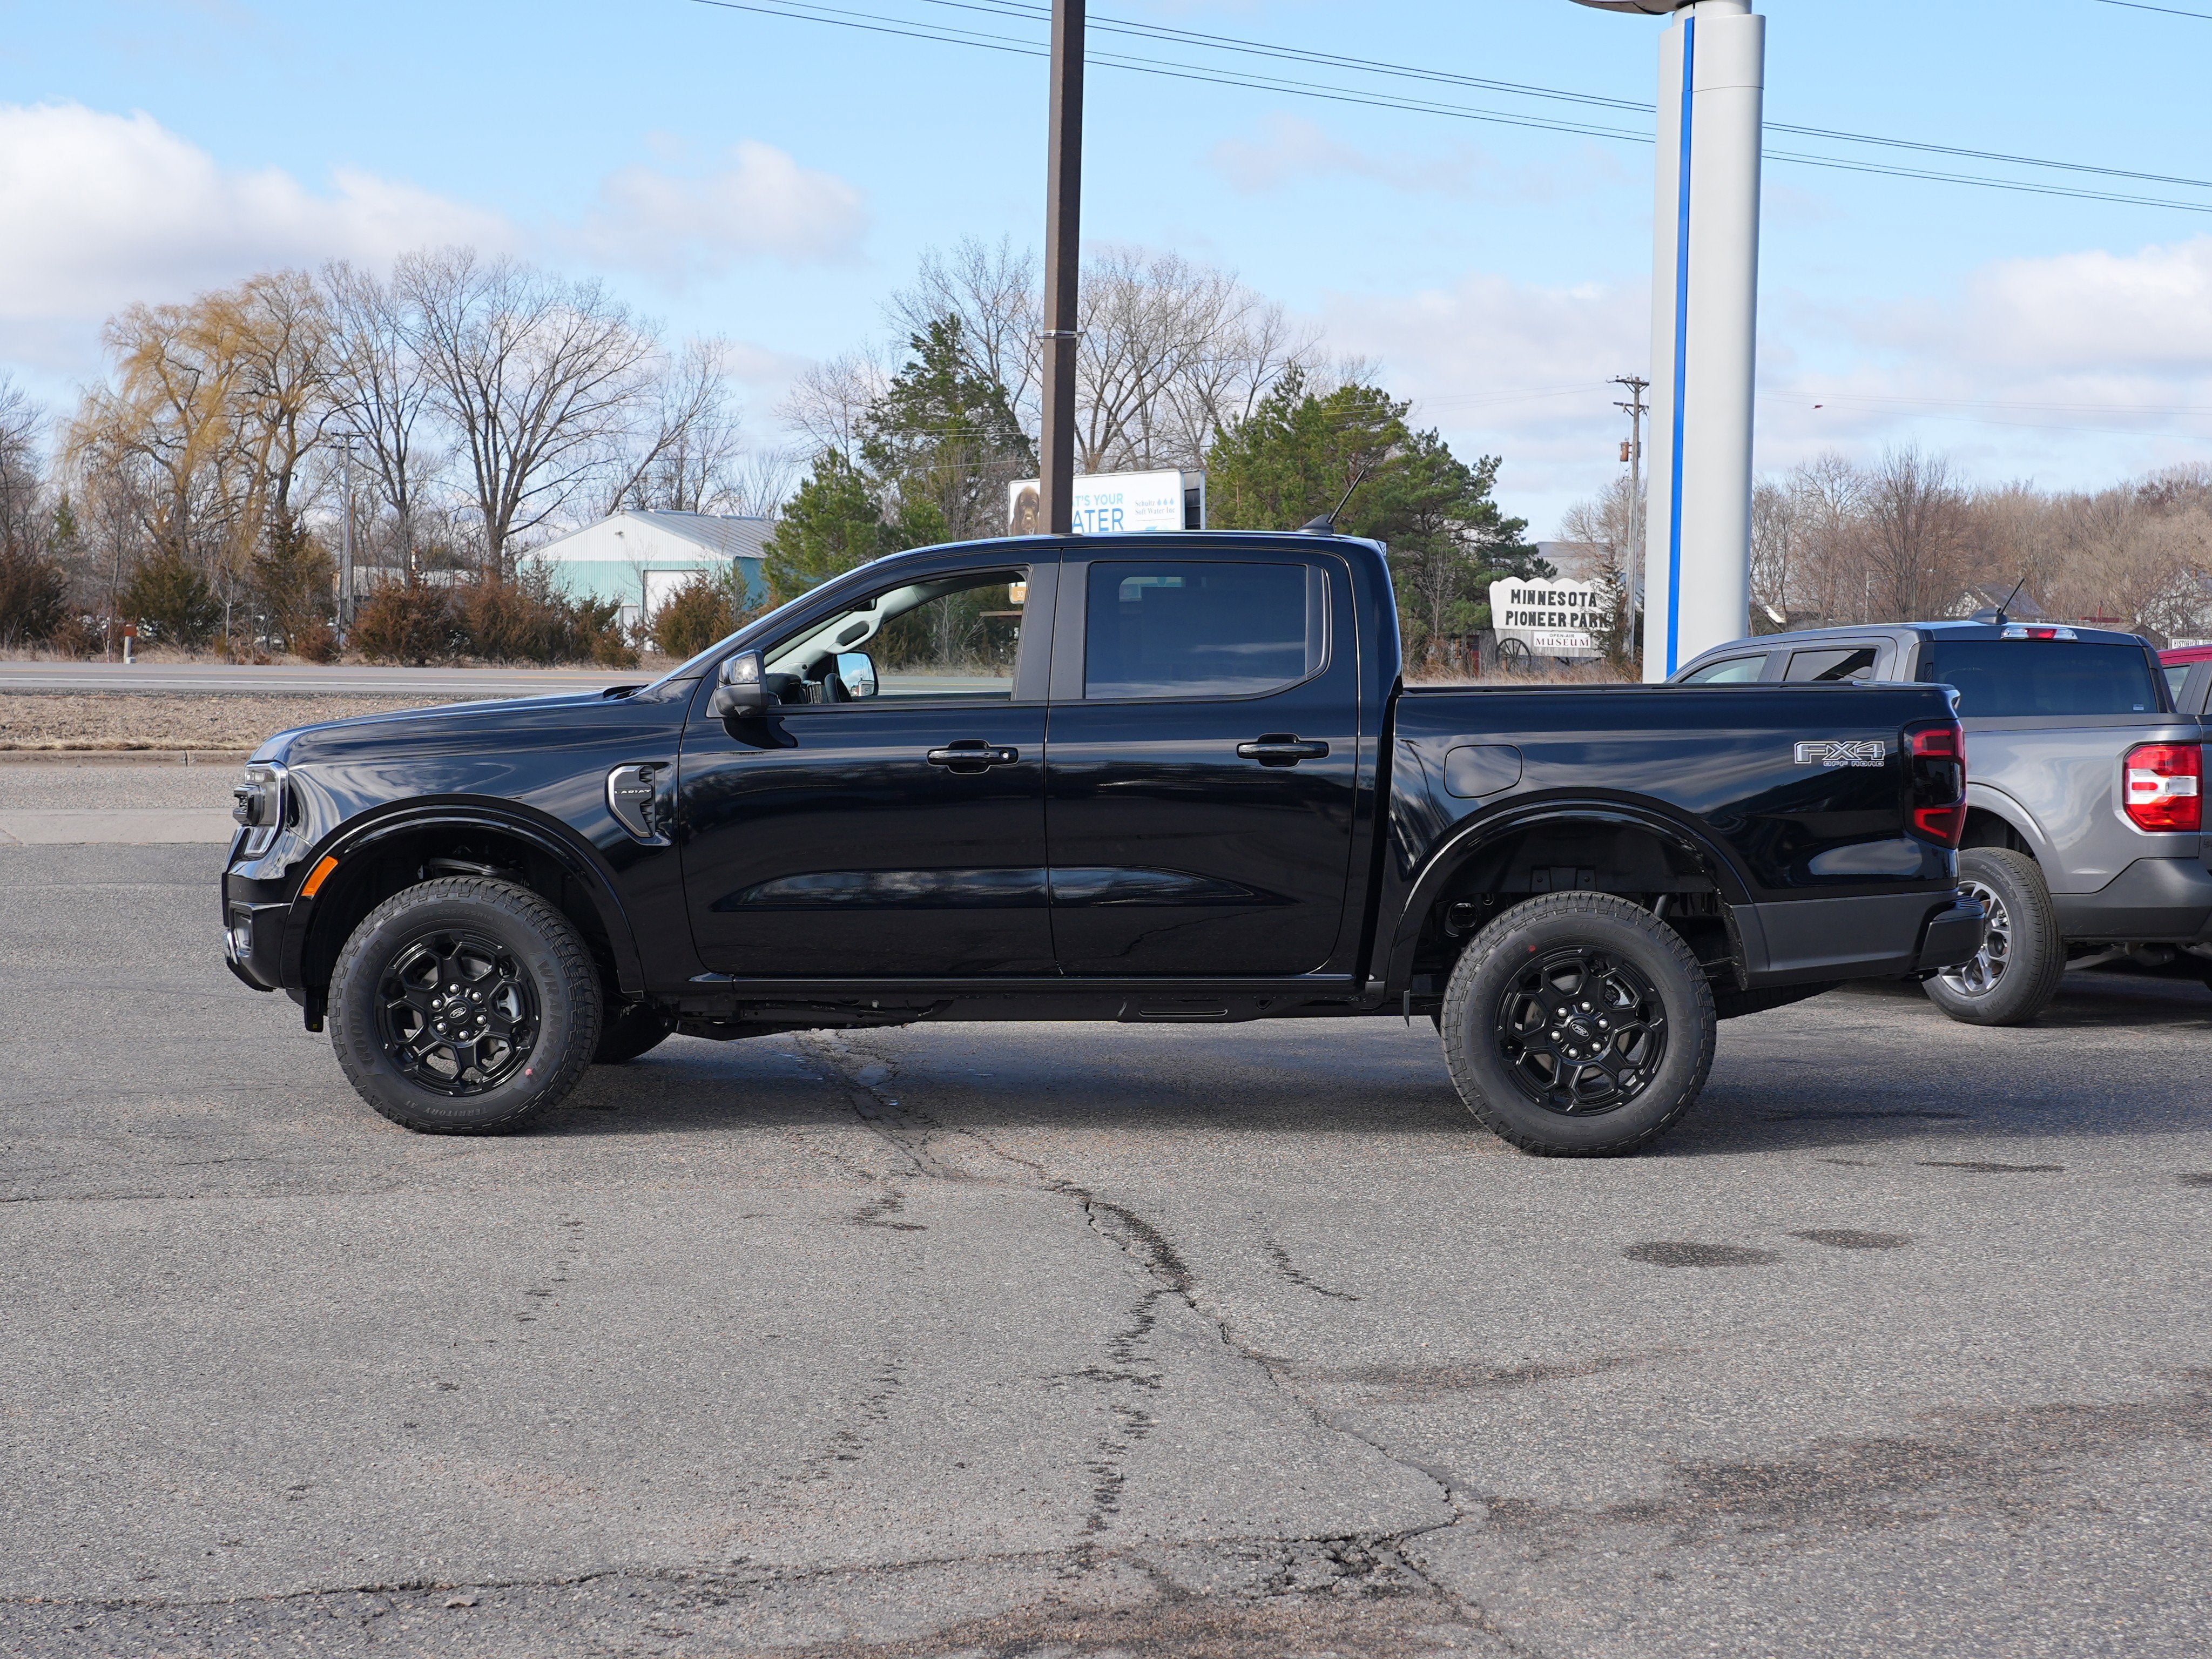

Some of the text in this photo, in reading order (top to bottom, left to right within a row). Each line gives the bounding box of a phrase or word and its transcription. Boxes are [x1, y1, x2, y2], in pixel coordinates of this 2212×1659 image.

[1072, 493, 1123, 507] T'S YOUR
[1510, 589, 1597, 607] MINNESOTA
[1506, 610, 1607, 628] PIONEER PARK
[1535, 638, 1589, 647] MUSEUM
[1794, 741, 1885, 764] FX4
[423, 1107, 488, 1117] TERRITORY
